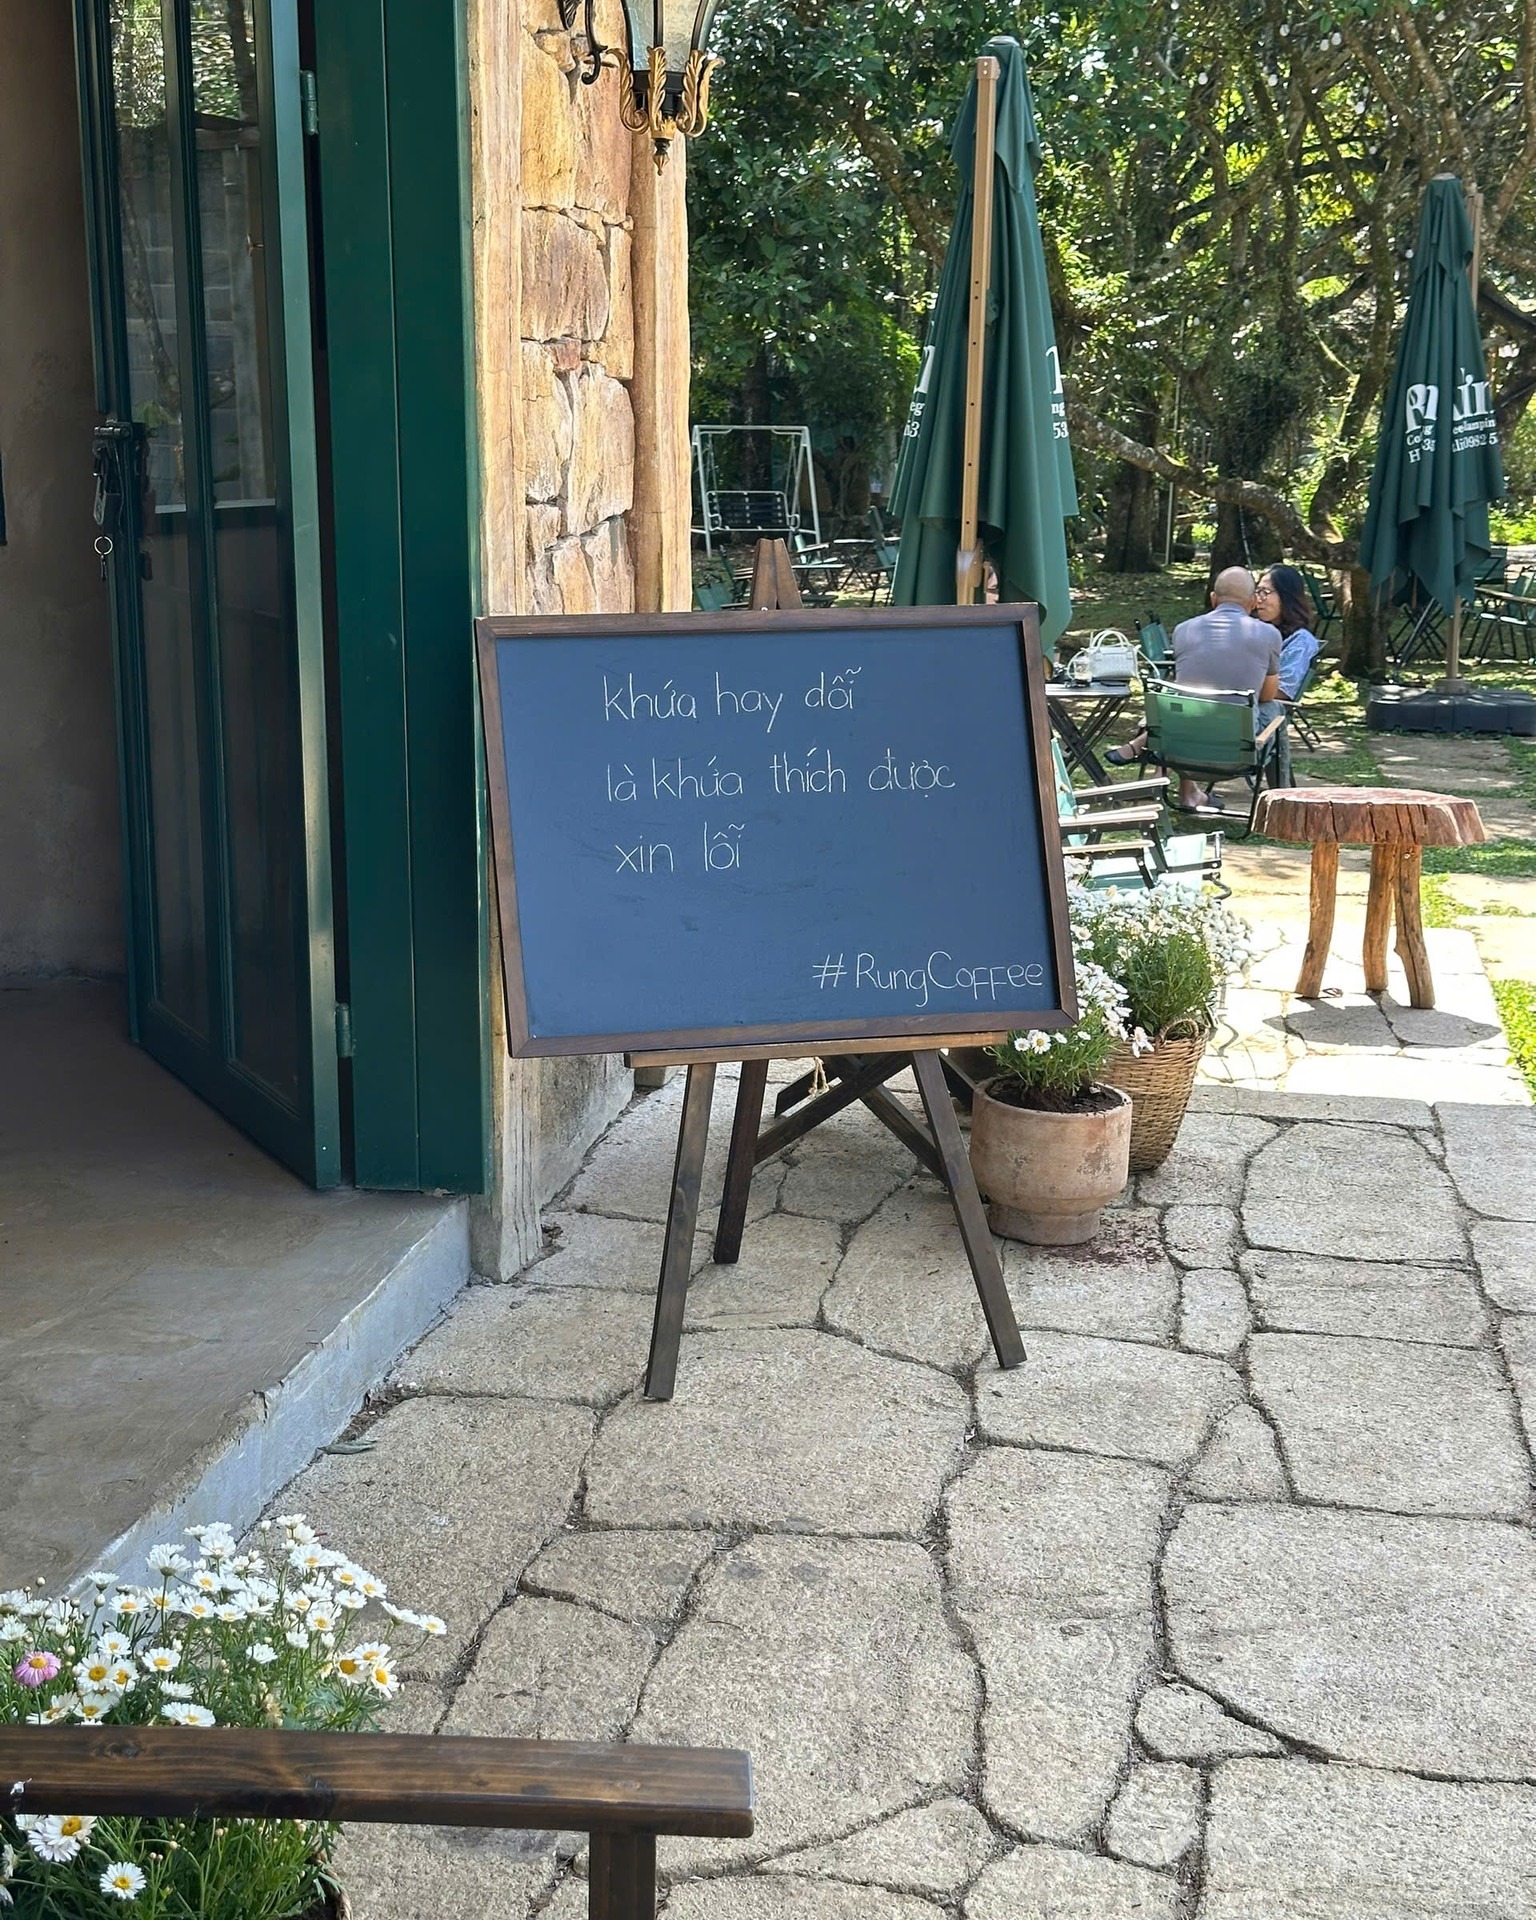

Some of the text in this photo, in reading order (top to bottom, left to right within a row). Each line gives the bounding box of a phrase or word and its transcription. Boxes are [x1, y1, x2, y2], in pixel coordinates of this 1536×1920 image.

[603, 666, 863, 734] khứa hay dỗi
[606, 746, 956, 802] là khứa thích được
[614, 821, 746, 874] xin lỗi
